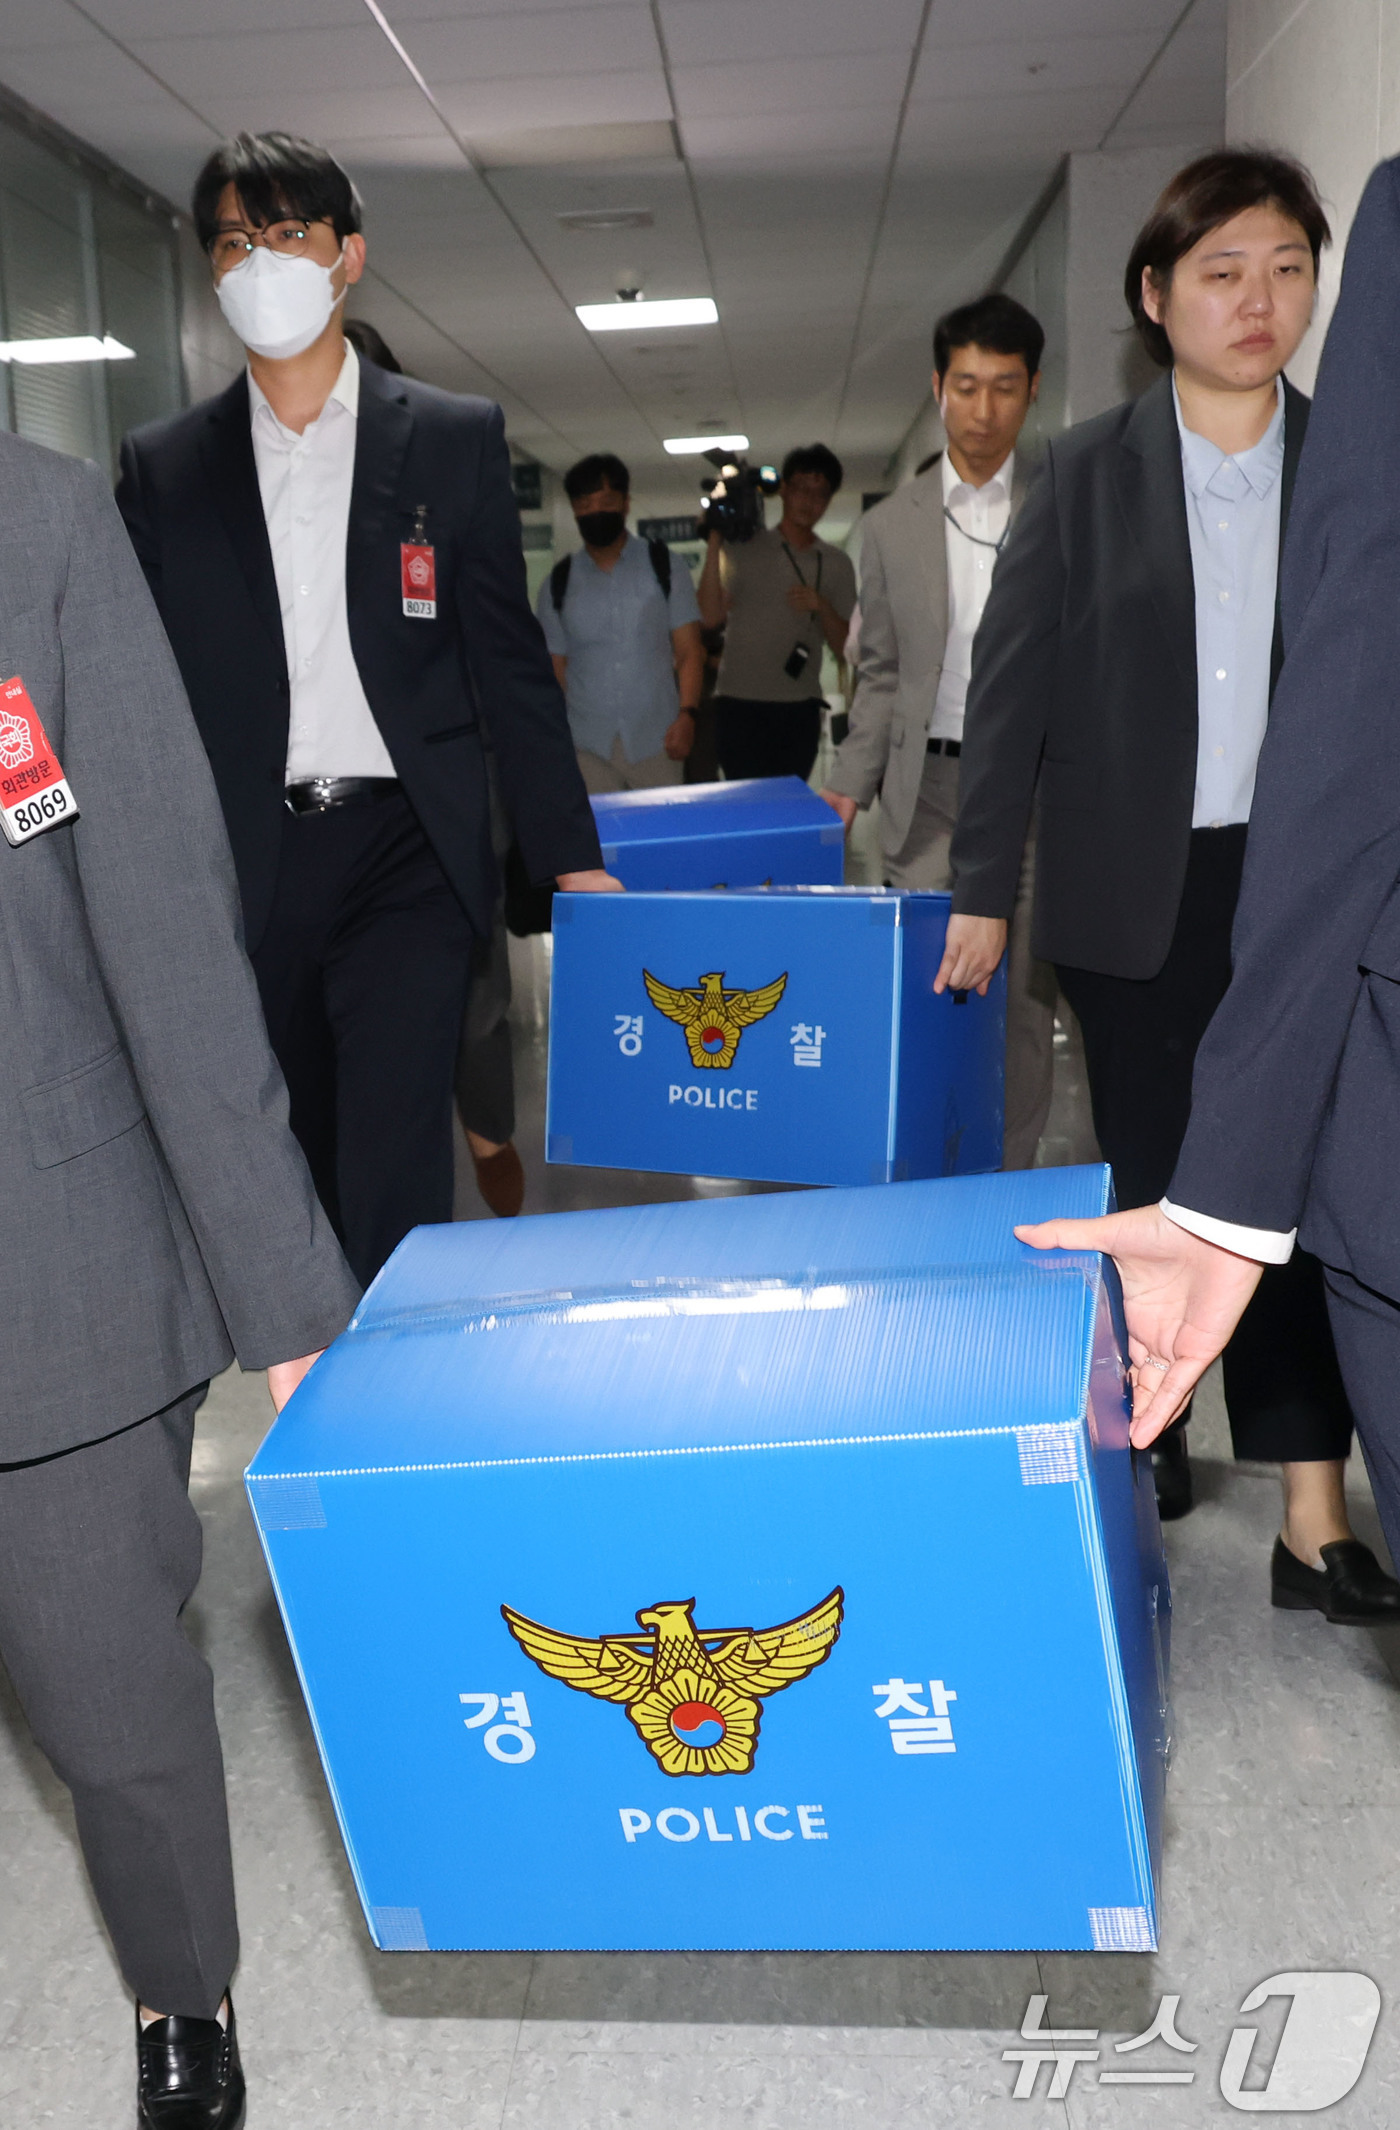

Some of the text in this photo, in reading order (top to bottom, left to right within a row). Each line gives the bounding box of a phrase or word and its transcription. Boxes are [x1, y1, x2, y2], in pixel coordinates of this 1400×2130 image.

[407, 601, 432, 615] 8073
[1, 760, 53, 795] 회관방문
[14, 788, 67, 832] 8069
[613, 1014, 826, 1067] 경 찰
[668, 1084, 758, 1111] POLICE
[458, 1678, 957, 1764] 경 찰
[618, 1804, 829, 1843] POLICE
